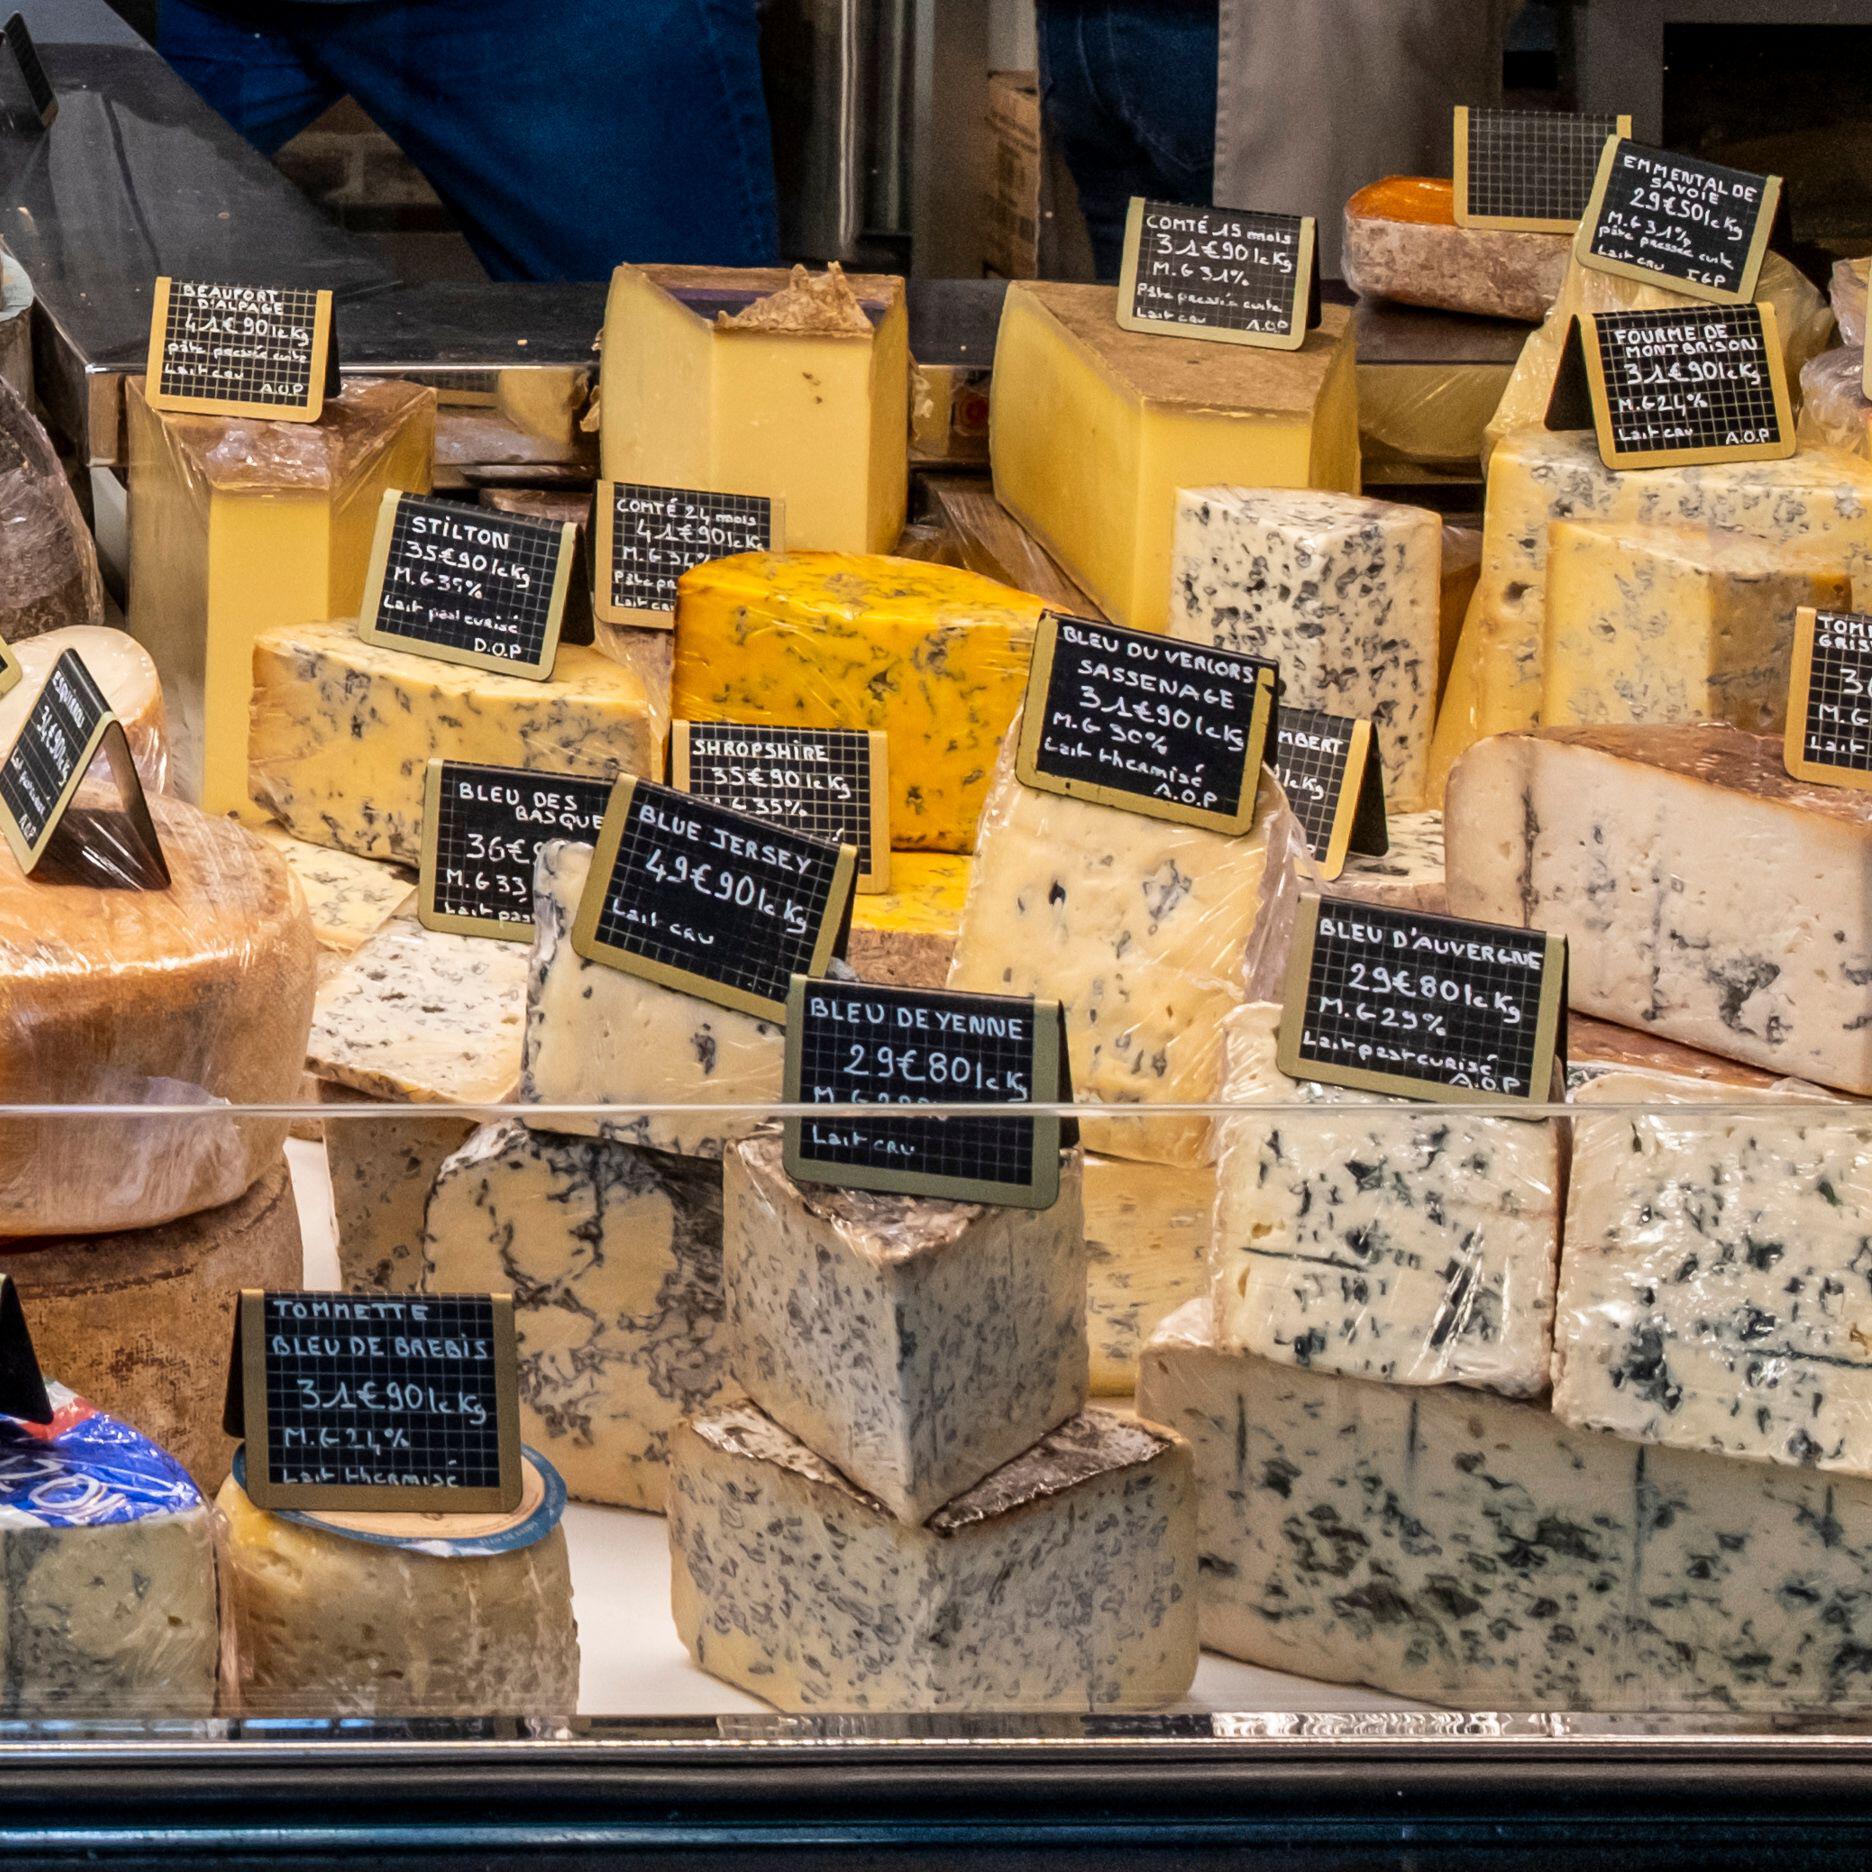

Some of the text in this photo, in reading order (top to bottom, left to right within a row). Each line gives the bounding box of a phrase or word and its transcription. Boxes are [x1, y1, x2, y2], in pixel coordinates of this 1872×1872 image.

[1624, 155, 1757, 202] EMMENTAL DE
[1650, 177, 1720, 204] SAVOIE
[1630, 187, 1703, 221] 29€50
[1147, 215, 1209, 234] COMTÉ
[1157, 234, 1248, 261] 31€90
[1200, 266, 1250, 286] 31%
[183, 284, 278, 303] BEAUFORT
[185, 312, 268, 335] 41€90
[1614, 324, 1729, 345] FOURME DE
[1624, 361, 1761, 386] 31€90 Kg
[1726, 428, 1770, 445] A.O.P
[616, 498, 678, 517] COMTÉ
[685, 505, 710, 525] 24
[412, 515, 510, 550] STILTON
[636, 519, 725, 545] 41€90
[406, 540, 531, 588] 35€90 Kg
[474, 638, 522, 659] D.O.P
[1062, 625, 1254, 684] BLEU DU VERCORS
[1077, 659, 1235, 709] SASSENAGE
[1079, 685, 1191, 728] 31€90
[692, 739, 830, 762] SHROPSHIRE
[711, 766, 851, 799] 35€90 Kg
[1154, 783, 1218, 808] A.O.P
[459, 782, 578, 811] BLEU DES
[515, 805, 605, 831] BASQUE
[639, 804, 812, 875] BLUE JERSEY
[645, 848, 807, 934] 49€90 Kg
[1319, 918, 1544, 970] BLEU D'AUVERGNE
[1349, 963, 1521, 1024] 29€80 Kg
[810, 997, 1024, 1041] BLEU DE YENNE
[1381, 1008, 1447, 1037] 29%
[843, 1044, 971, 1084] 29€80
[1448, 1073, 1521, 1094] A.O.P
[273, 1300, 429, 1321] TOMMETTE
[272, 1333, 489, 1360] BLEU DE BREBIS
[296, 1379, 487, 1425] 31€90 Kg
